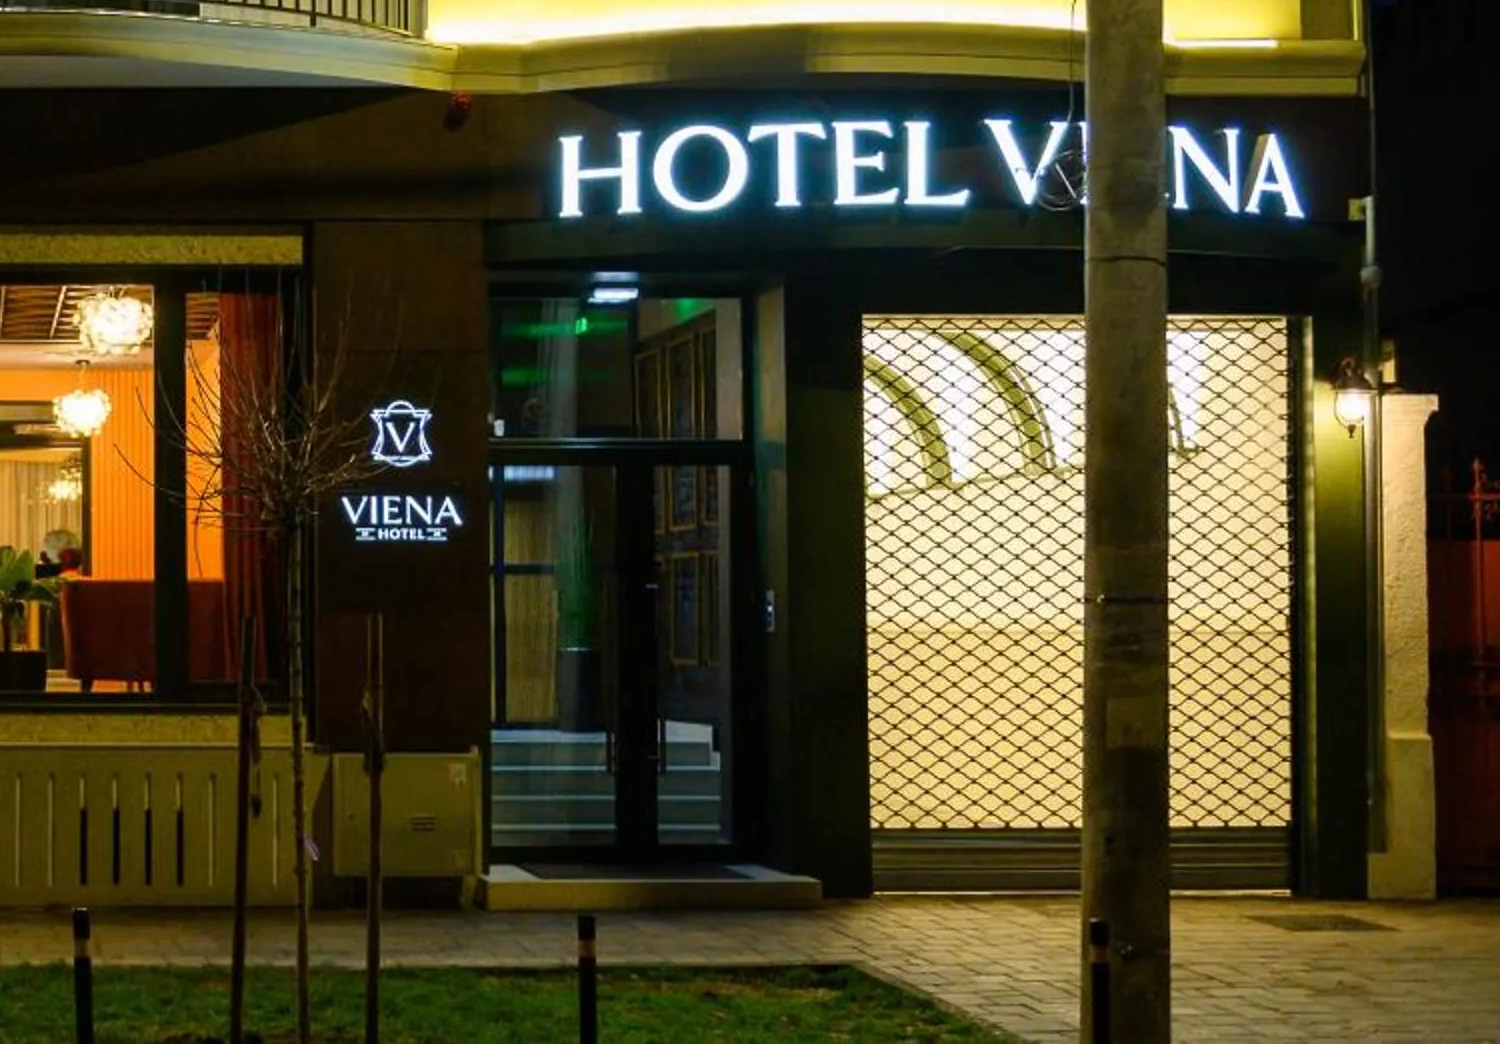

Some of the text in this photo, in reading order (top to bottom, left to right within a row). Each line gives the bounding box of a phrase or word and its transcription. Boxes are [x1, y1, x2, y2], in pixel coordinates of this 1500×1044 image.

[557, 117, 1306, 220] HOTEL VNA
[385, 421, 416, 454] V
[340, 494, 464, 526] VIENA
[377, 527, 427, 541] HOTEL
